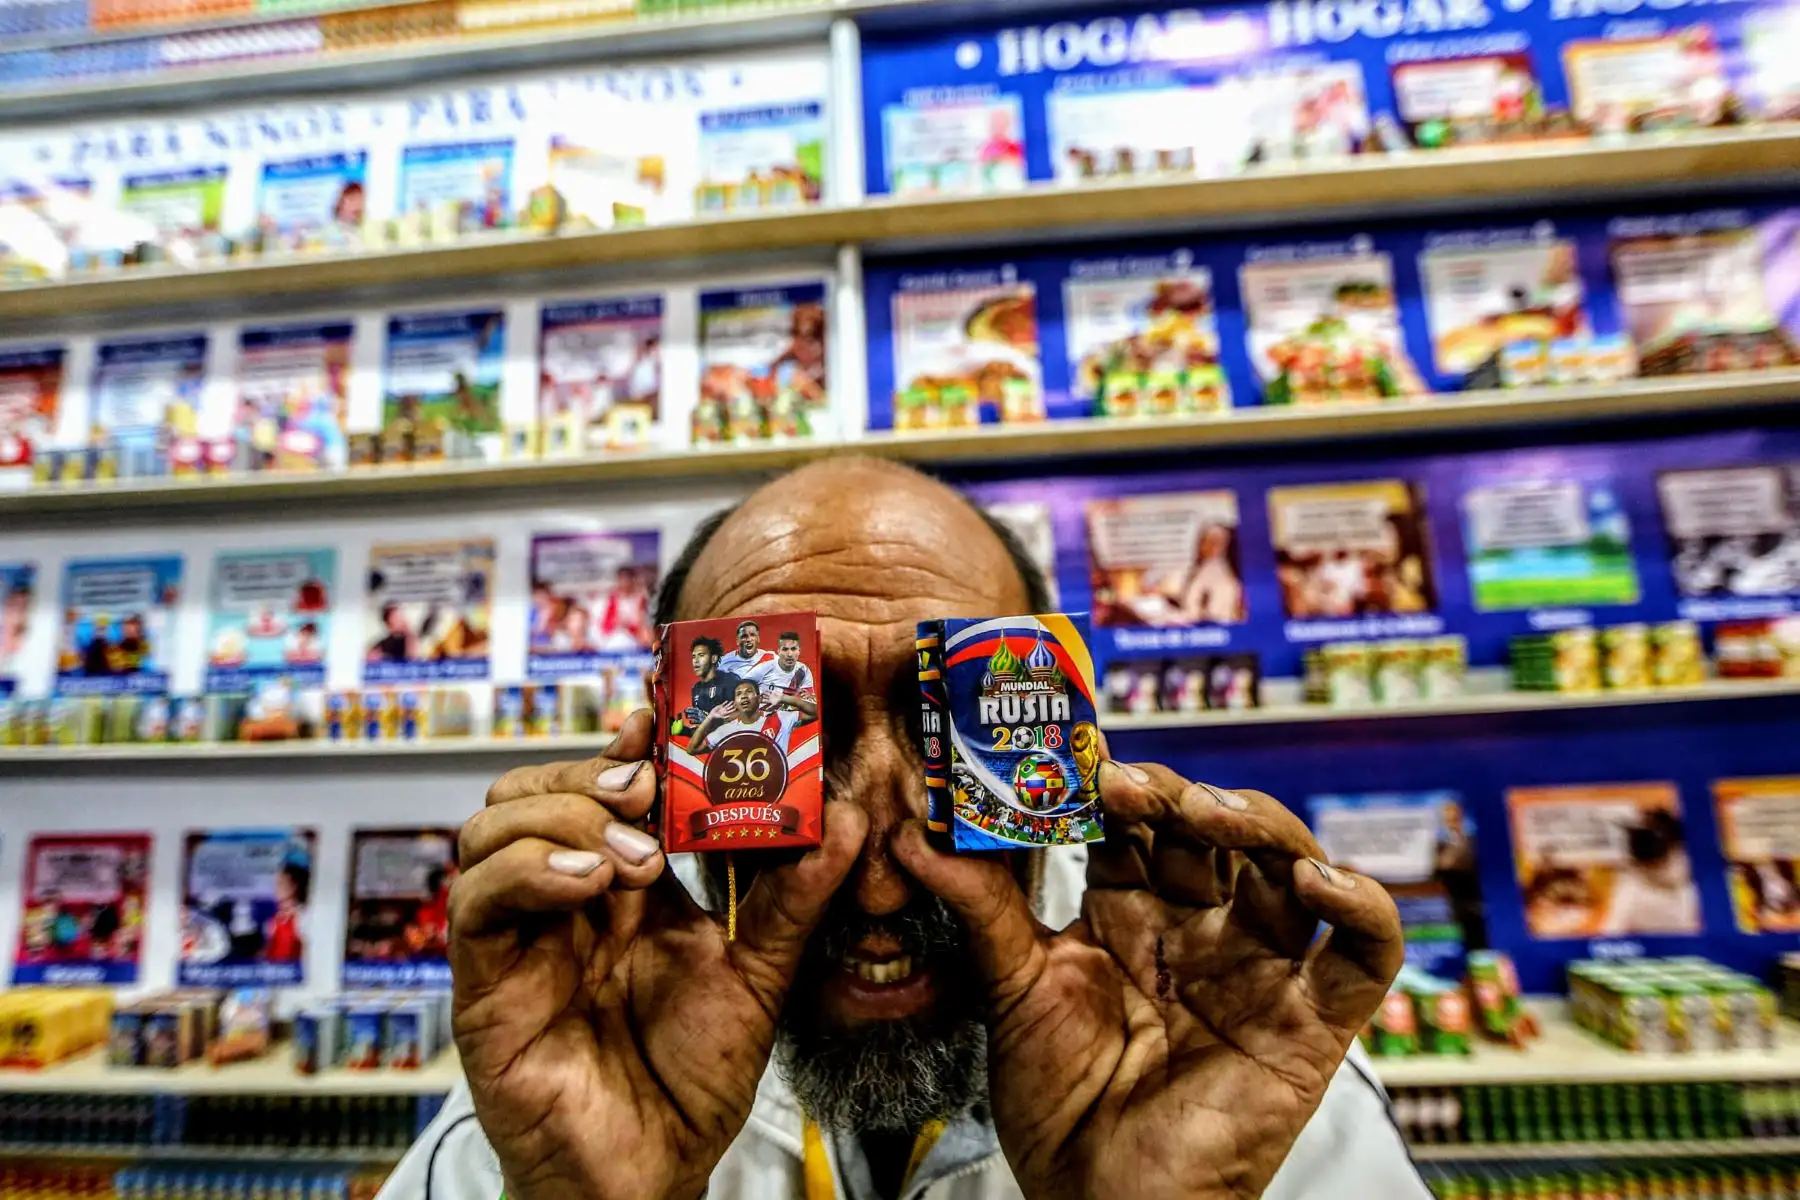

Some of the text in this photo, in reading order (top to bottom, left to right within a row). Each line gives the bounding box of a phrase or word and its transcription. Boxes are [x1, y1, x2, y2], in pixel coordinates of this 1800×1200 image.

[1000, 681, 1050, 693] MUNDIAL
[978, 694, 1071, 725] RUSIA
[992, 724, 1064, 752] 2018
[719, 747, 771, 783] 36
[724, 781, 765, 800] años
[705, 803, 782, 826] DESPUÉS
